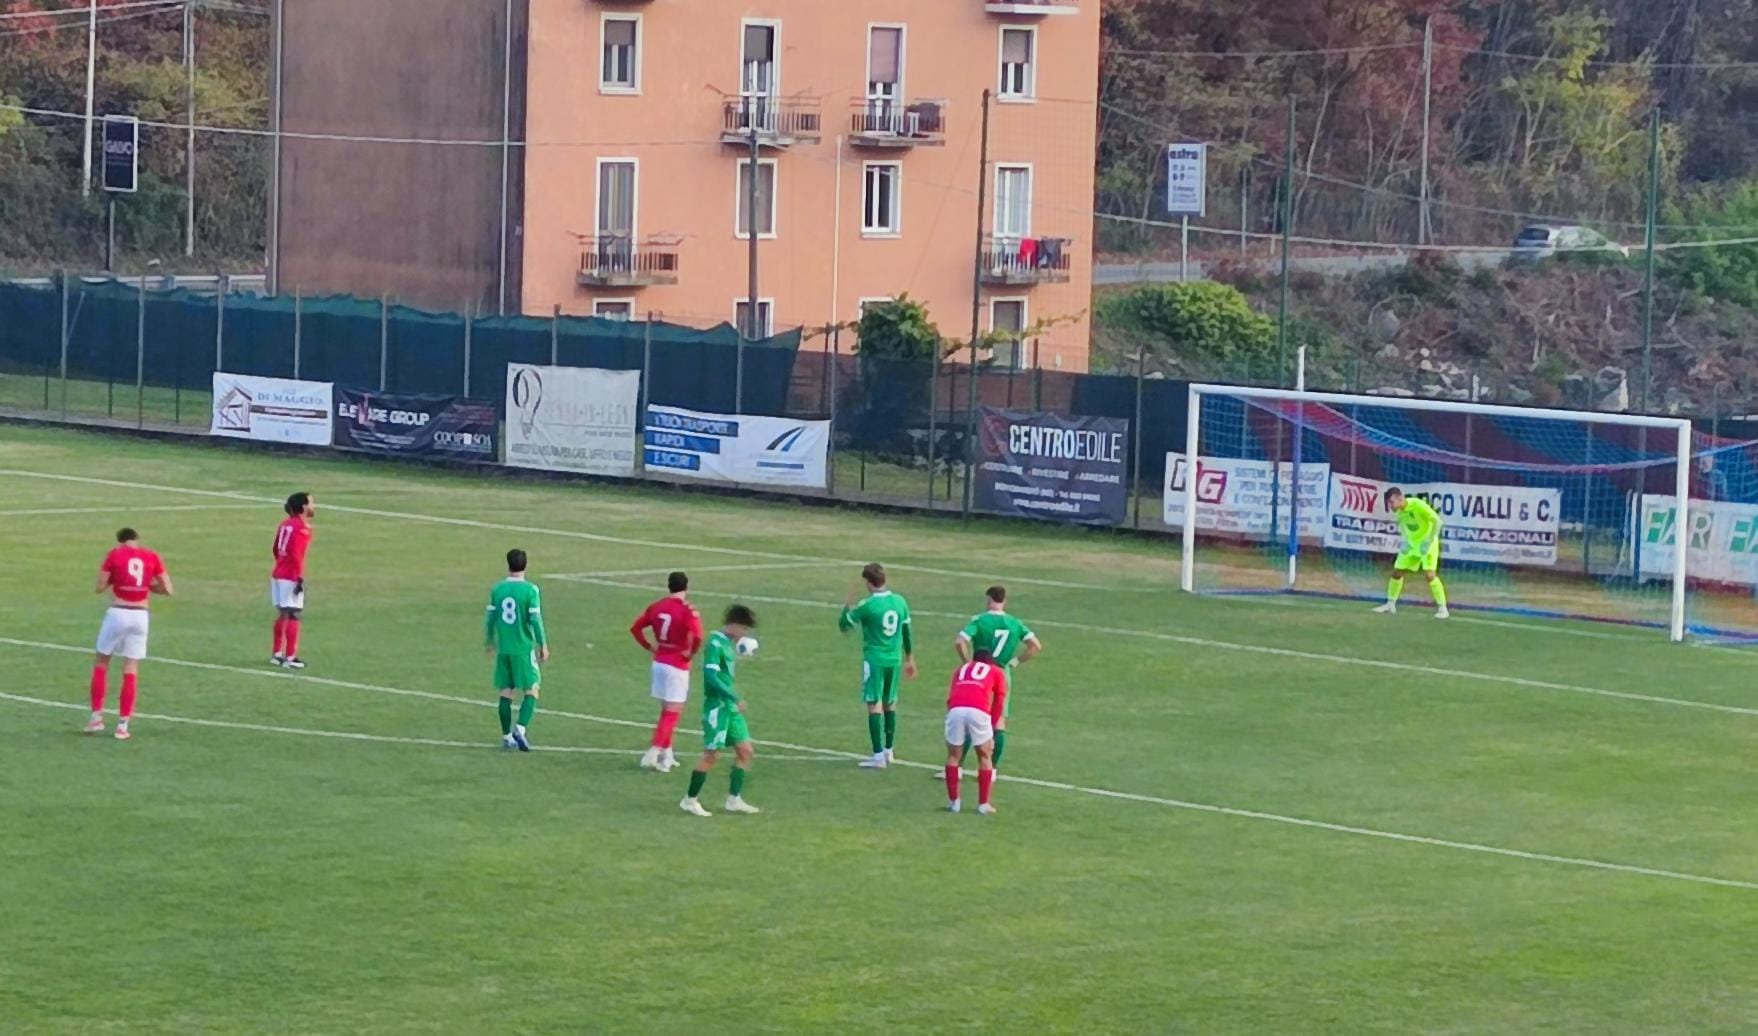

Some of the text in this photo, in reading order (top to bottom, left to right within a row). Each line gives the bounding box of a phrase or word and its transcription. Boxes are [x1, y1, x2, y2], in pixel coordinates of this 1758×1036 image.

[389, 410, 430, 426] GROUP
[1009, 424, 1123, 463] CENTROEDILE
[1460, 494, 1512, 520] VALLI
[1518, 502, 1530, 521] &
[1536, 499, 1555, 522] C.
[127, 557, 144, 587] 9
[501, 596, 517, 625] 8
[882, 609, 899, 637] 9
[658, 612, 672, 641] 7
[992, 629, 1010, 658] 7
[958, 661, 991, 681] 10
